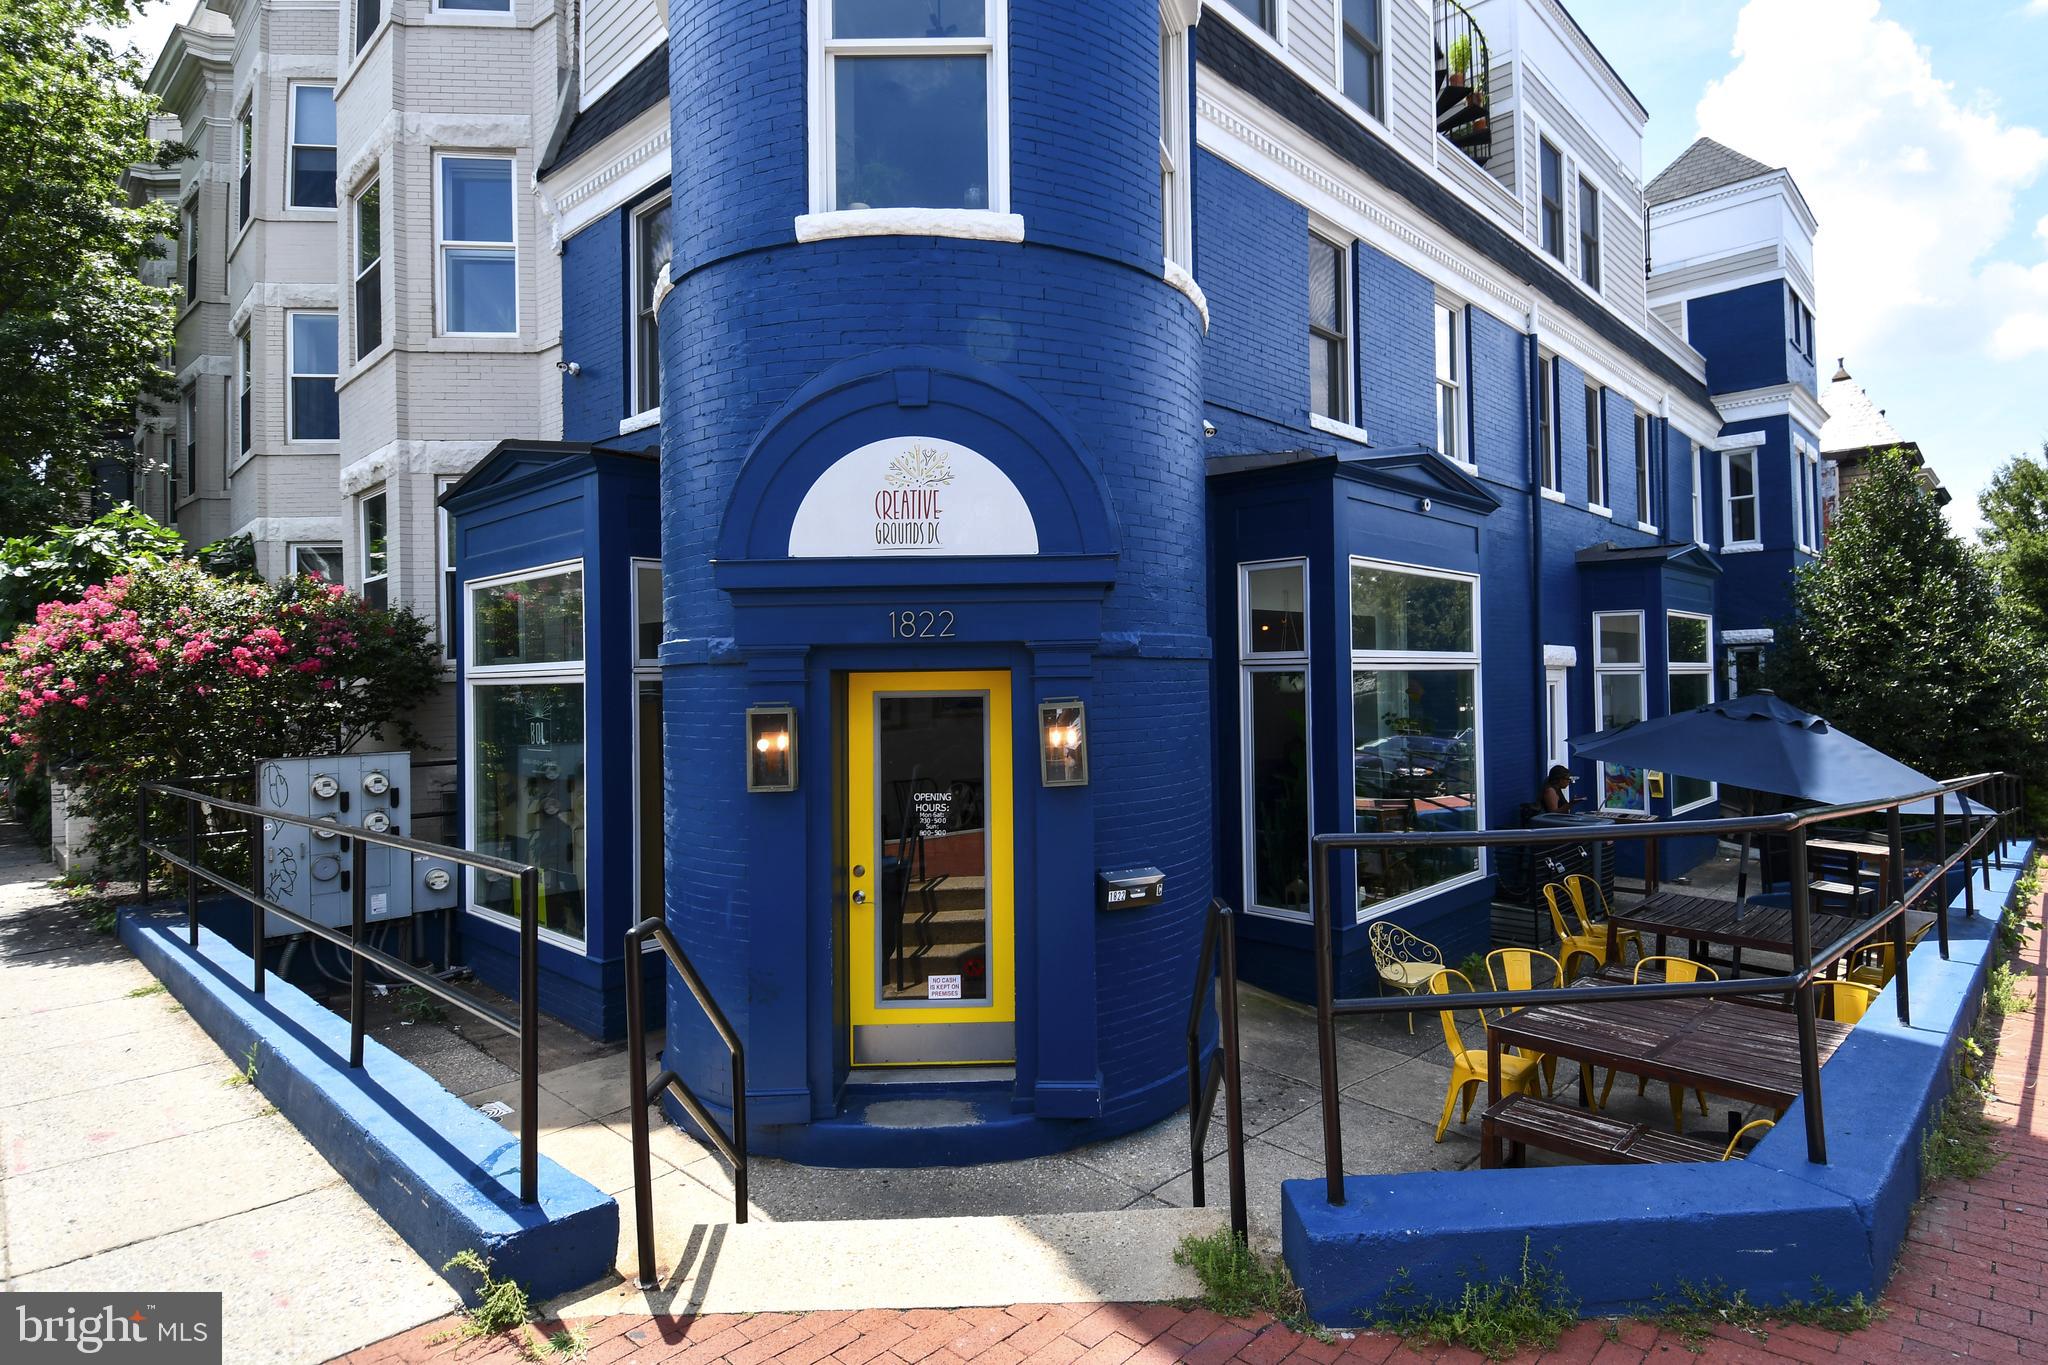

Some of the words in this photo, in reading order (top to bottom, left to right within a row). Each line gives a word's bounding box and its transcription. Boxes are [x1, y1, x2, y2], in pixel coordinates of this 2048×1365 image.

[875, 489, 942, 520] CREATIVE
[875, 521, 924, 545] GROUNDS
[889, 610, 956, 638] 1822
[914, 793, 952, 801] OPENING
[915, 803, 950, 812] HOURS:
[1109, 891, 1126, 901] 1822
